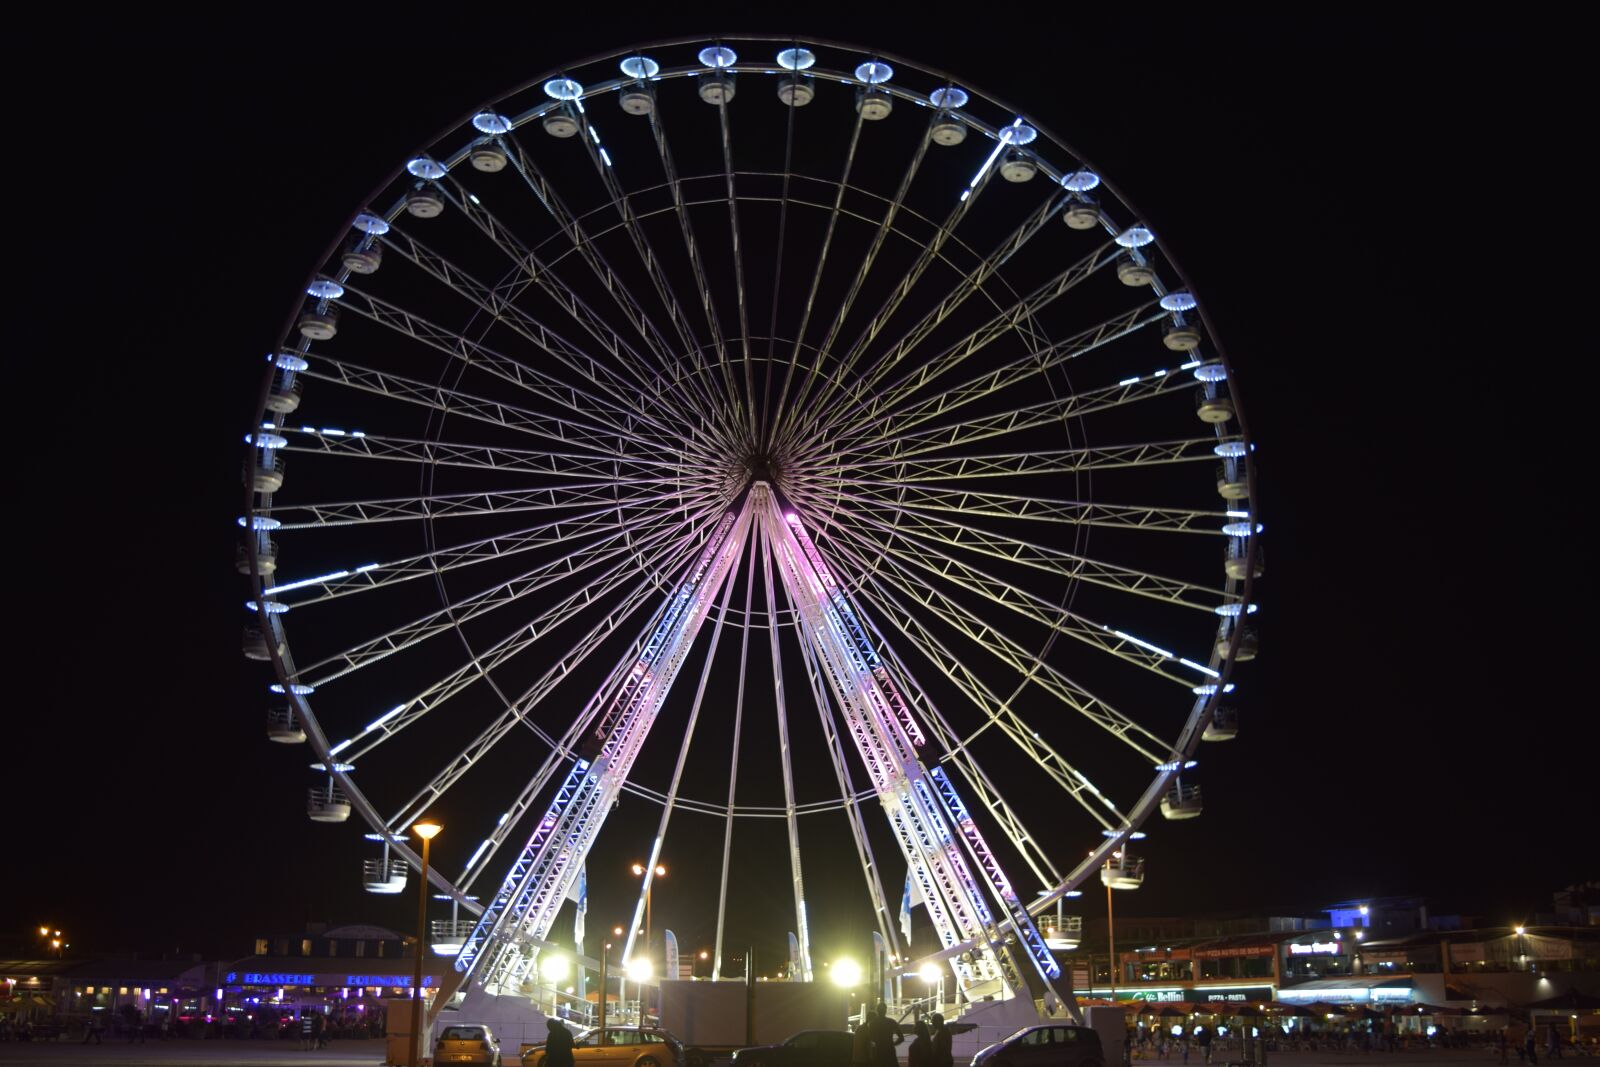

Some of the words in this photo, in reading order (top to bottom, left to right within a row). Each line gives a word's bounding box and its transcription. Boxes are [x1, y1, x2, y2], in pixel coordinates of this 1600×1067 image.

[244, 973, 315, 985] BRASSERIE
[1157, 991, 1185, 1002] Bellini
[1228, 993, 1247, 1001] PASTA
